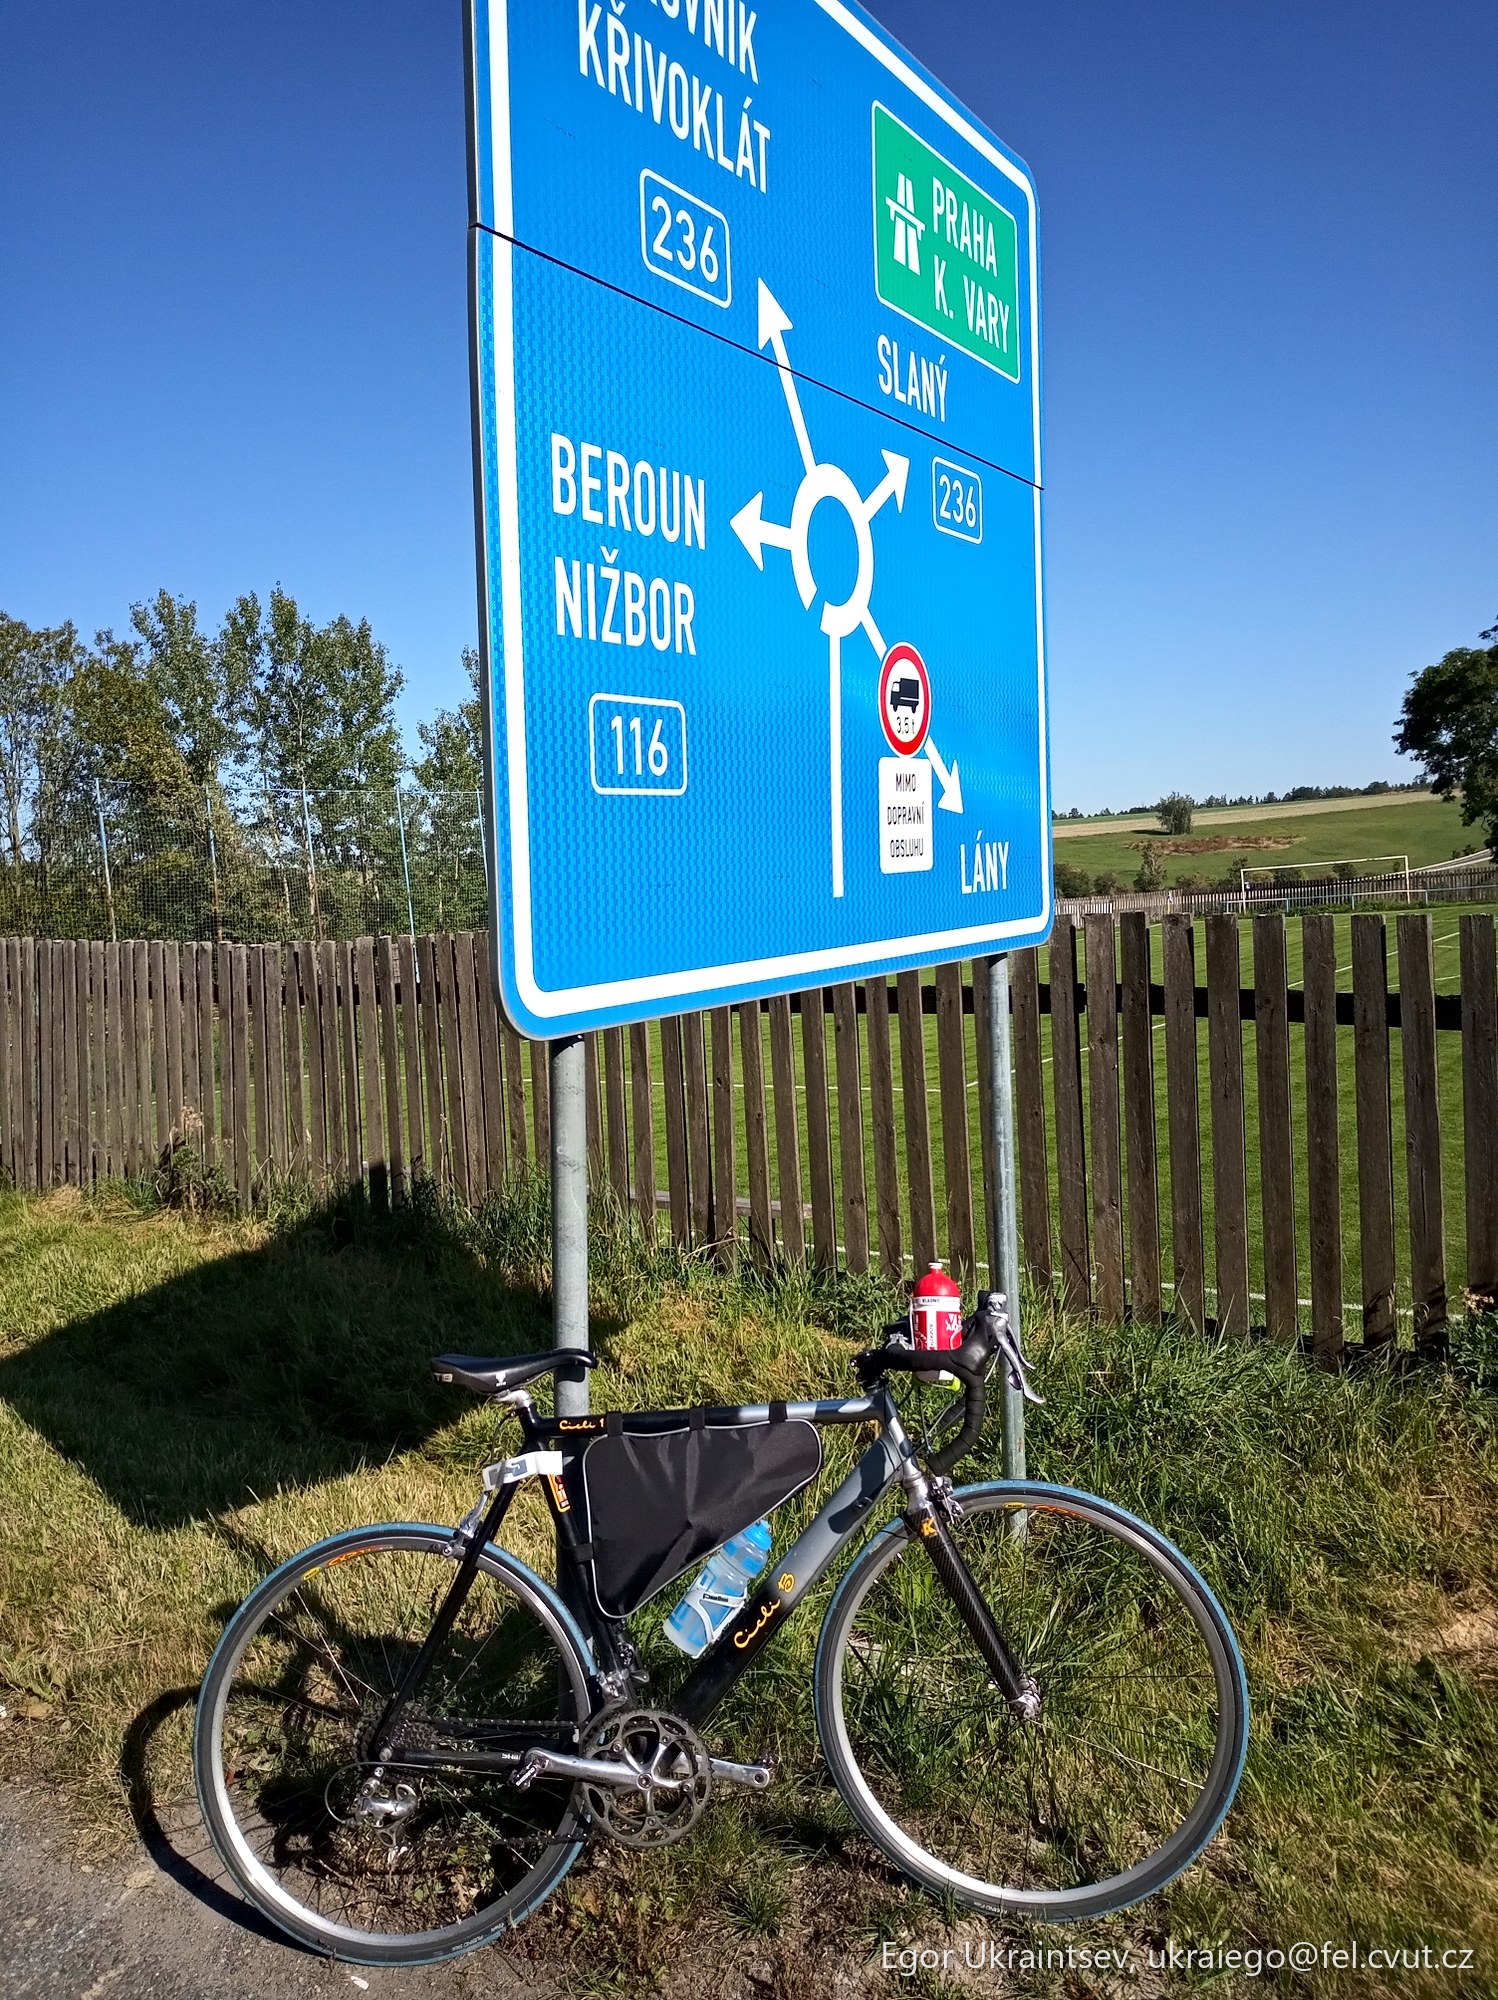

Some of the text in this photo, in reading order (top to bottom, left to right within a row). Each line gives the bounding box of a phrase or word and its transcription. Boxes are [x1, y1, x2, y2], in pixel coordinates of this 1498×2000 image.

[578, 0, 771, 194] KŘIVOKLÁT
[652, 197, 719, 283] 236
[932, 176, 998, 277] PRAHA
[933, 254, 1010, 353] K. VARY
[877, 334, 948, 422] SLANÝ
[551, 432, 706, 550] BEROUN
[938, 474, 976, 528] 236
[554, 546, 696, 655] NIŽBOR
[610, 715, 668, 777] 116
[895, 773, 916, 792] MIMO
[887, 801, 925, 825] DOPRAVNÍ
[889, 838, 924, 858] OBSLUHU
[960, 830, 1009, 894] LÁNY
